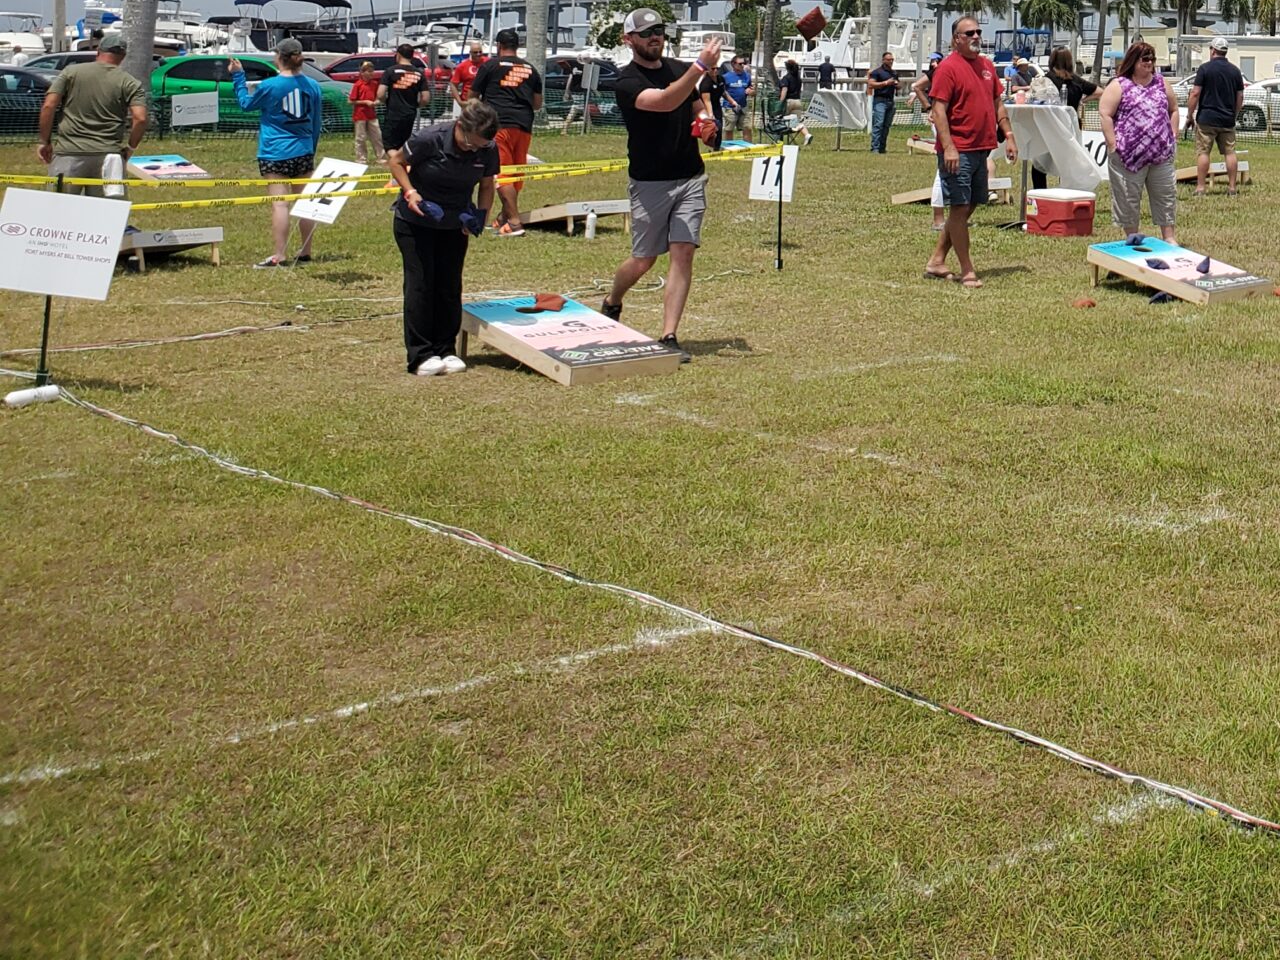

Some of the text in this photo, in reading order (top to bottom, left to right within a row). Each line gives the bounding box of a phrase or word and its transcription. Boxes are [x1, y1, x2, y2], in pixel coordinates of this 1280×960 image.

[760, 156, 785, 187] 11
[310, 170, 350, 205] 12
[29, 227, 109, 245] CROWNE PLAZA
[523, 324, 617, 339] GULFPOINT
[593, 344, 664, 357] CREATIVE
